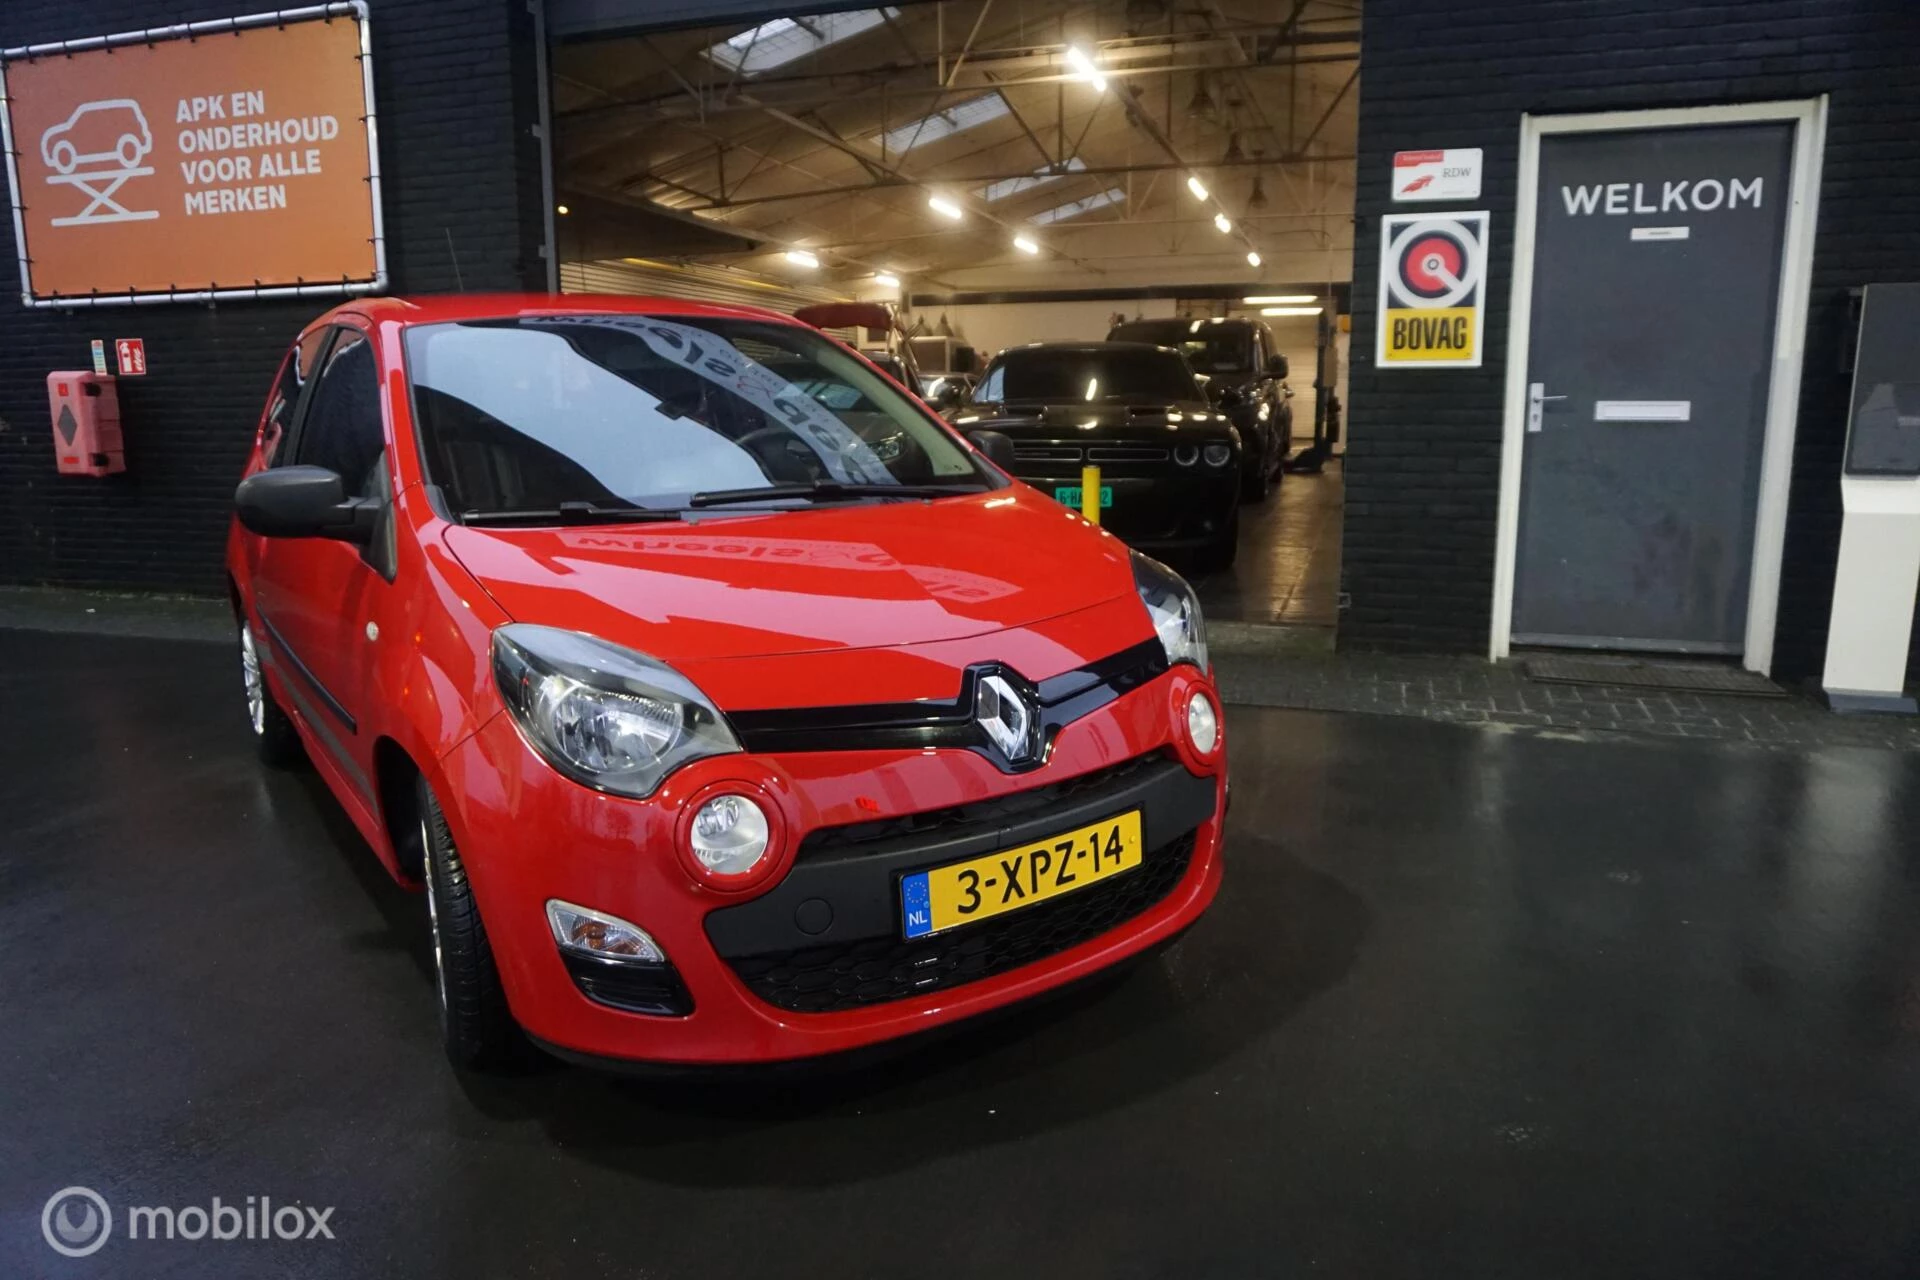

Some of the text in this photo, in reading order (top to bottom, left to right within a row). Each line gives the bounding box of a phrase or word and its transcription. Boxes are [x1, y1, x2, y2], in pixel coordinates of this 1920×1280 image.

[176, 90, 265, 124] APK EN
[178, 115, 339, 154] ONDERHOUD
[181, 149, 322, 185] VOOR ALLE
[1442, 167, 1472, 178] RDW
[184, 184, 287, 216] MERKEN
[1561, 176, 1764, 216] WELKOM
[1393, 316, 1468, 350] BOVAG
[957, 824, 1124, 915] 3-XPZ-14
[908, 910, 928, 927] NL
